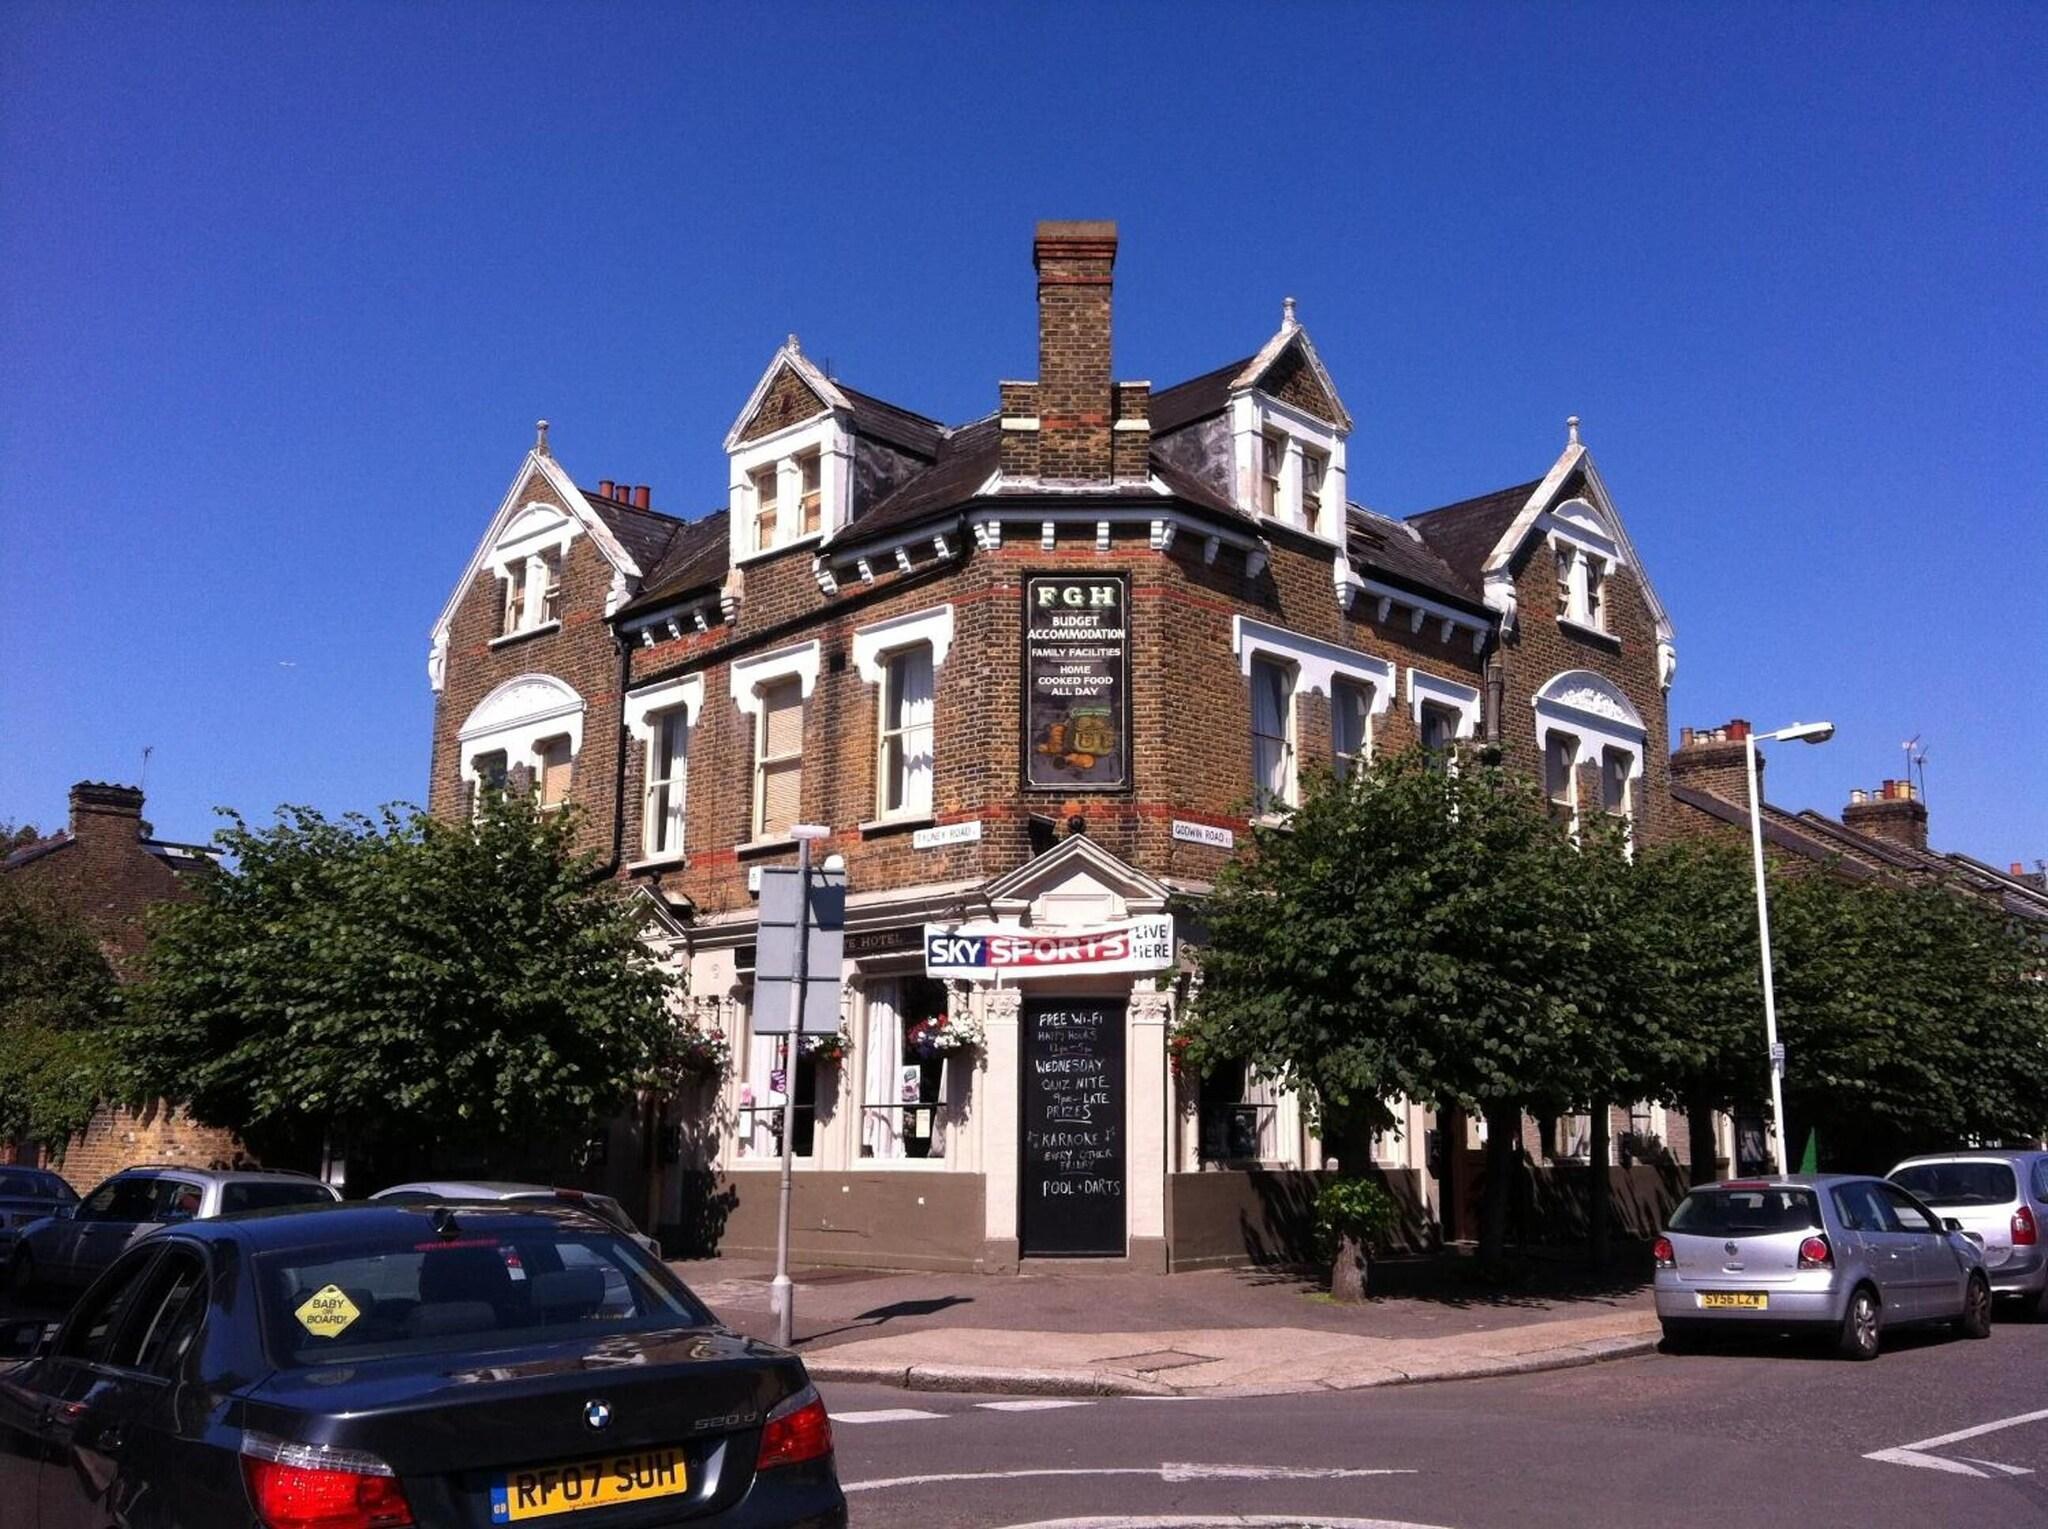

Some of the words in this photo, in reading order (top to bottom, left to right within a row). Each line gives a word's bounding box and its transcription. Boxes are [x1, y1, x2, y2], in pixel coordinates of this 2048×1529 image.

[1037, 586, 1116, 607] FGH
[1052, 616, 1099, 626] BUDGET
[1027, 628, 1125, 639] ACCOMMODATION
[1031, 648, 1066, 656] FAMILY
[1069, 648, 1121, 656] FACILITIES
[1060, 665, 1091, 674] HOME
[1038, 676, 1081, 685] COOKED
[1083, 676, 1113, 685] FOOD
[1051, 687, 1072, 696] ALL
[1075, 687, 1099, 696] DAY
[949, 826, 972, 840] ROAD
[1175, 824, 1203, 838] GODWIN
[1205, 829, 1224, 842] ROAD
[1135, 924, 1167, 939] LIVE
[861, 933, 902, 947] HOTEL
[930, 938, 981, 963] SKY
[990, 932, 1128, 964] SPORTS
[1133, 944, 1169, 958] HERE
[1039, 1012, 1067, 1027] FREE
[1035, 1059, 1105, 1073] WEDNESDAY
[1041, 1078, 1070, 1091] QUIZ
[1075, 1075, 1110, 1090] NITE
[1083, 1092, 1110, 1104] LATE
[1046, 1104, 1091, 1120] PRIZES
[1042, 1131, 1099, 1147] KARAOKE
[1043, 1180, 1074, 1197] POOL
[1084, 1179, 1120, 1195] DARTS
[312, 1299, 345, 1309] BABY
[516, 1461, 604, 1509] RF07
[613, 1451, 677, 1493] SUH
[493, 1503, 506, 1514] GB
